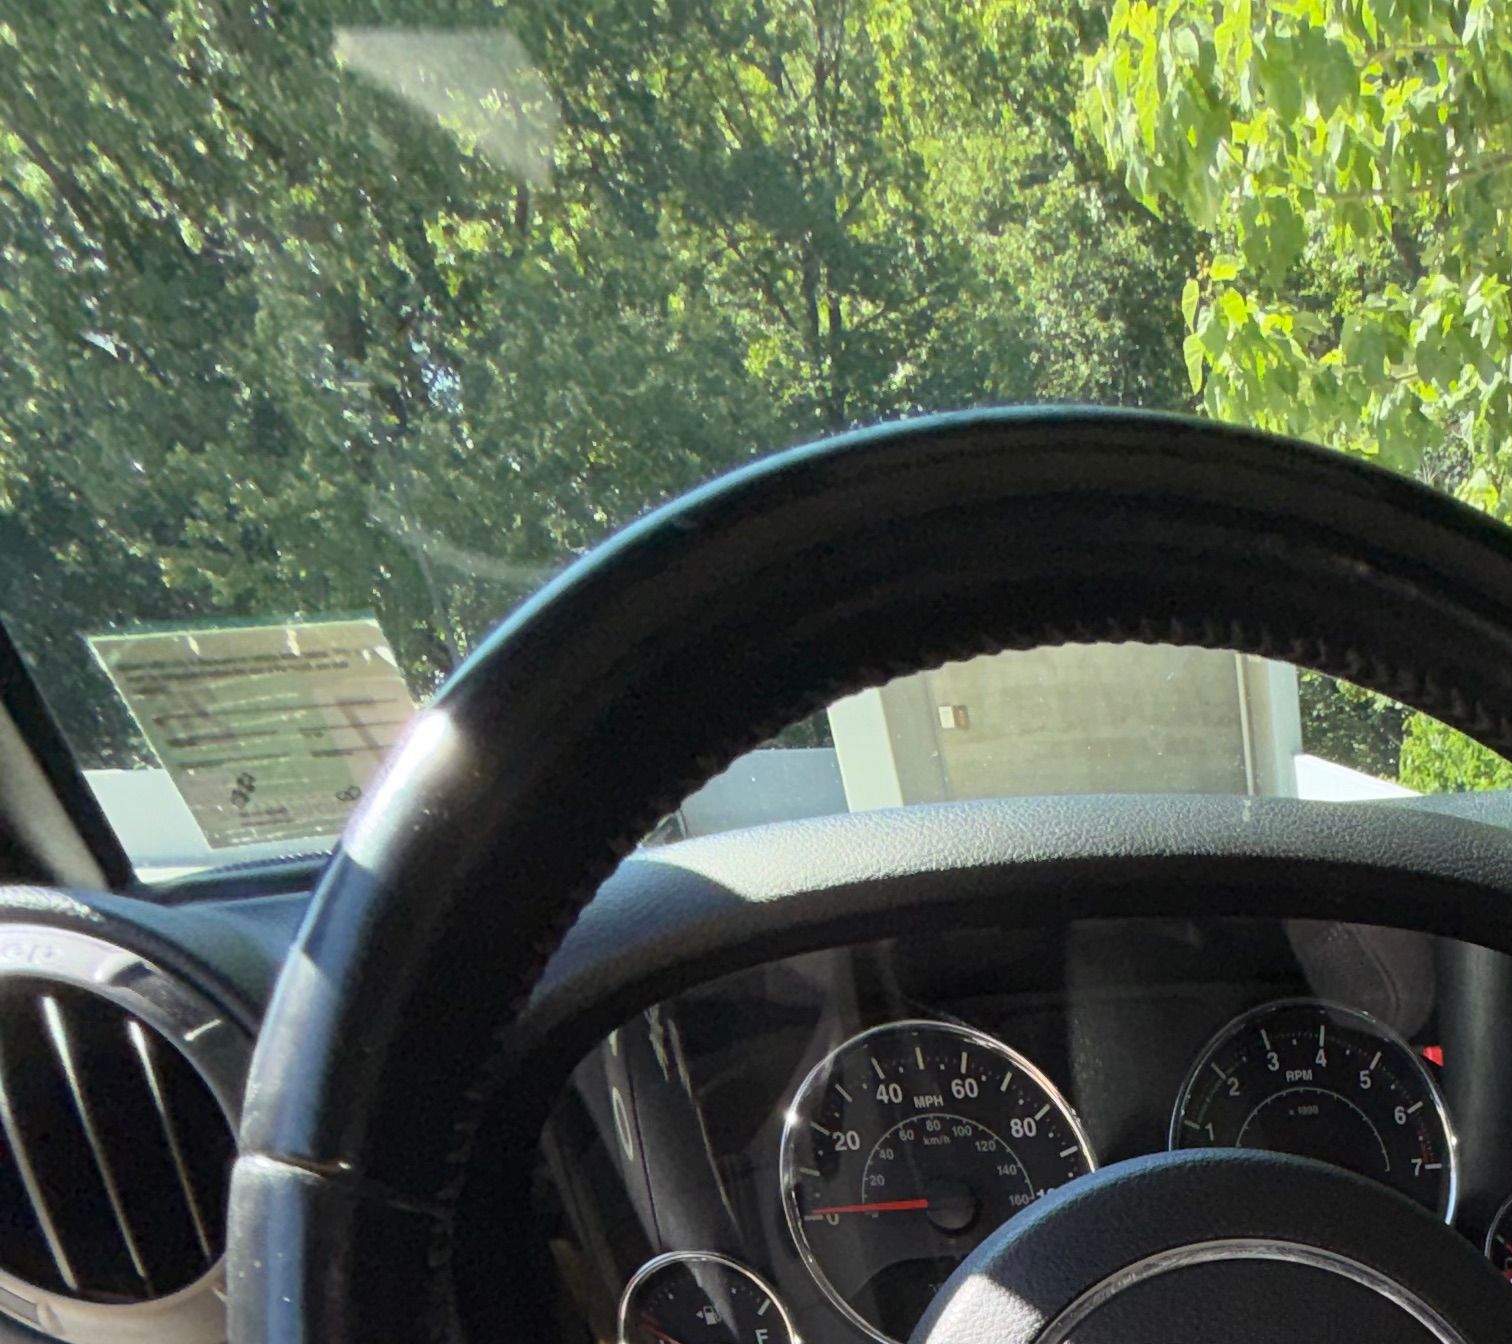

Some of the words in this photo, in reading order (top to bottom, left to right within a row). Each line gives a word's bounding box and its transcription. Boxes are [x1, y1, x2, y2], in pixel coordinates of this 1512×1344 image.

[1267, 1052, 1280, 1071] 3
[1315, 1050, 1327, 1067] 4
[1285, 1070, 1313, 1082] RPM
[1359, 1070, 1371, 1089] 5
[876, 1083, 903, 1103] 40
[951, 1078, 978, 1099] 60
[1227, 1076, 1240, 1097] 2
[913, 1095, 944, 1109] MPH
[1394, 1106, 1407, 1125] 6
[926, 1120, 941, 1132] 80
[952, 1125, 973, 1137] 100
[1009, 1117, 1037, 1139] 80
[1204, 1122, 1215, 1141] 1
[832, 1130, 860, 1151] 20
[900, 1130, 914, 1141] 60
[923, 1135, 951, 1146] km/h
[975, 1140, 996, 1152] 120
[879, 1149, 894, 1161] 40
[997, 1164, 1017, 1176] 140
[1410, 1158, 1422, 1177] 7
[869, 1174, 885, 1186] 20
[1008, 1193, 1029, 1206] 160
